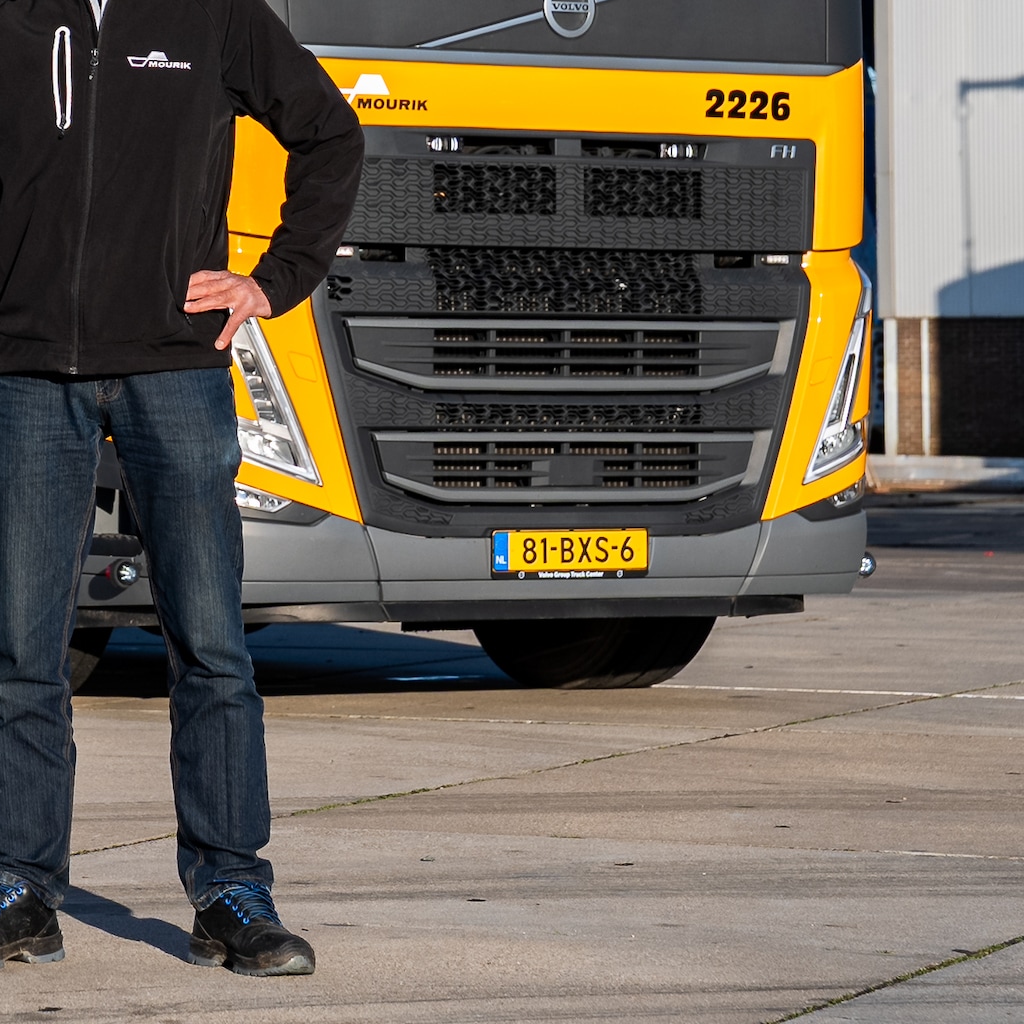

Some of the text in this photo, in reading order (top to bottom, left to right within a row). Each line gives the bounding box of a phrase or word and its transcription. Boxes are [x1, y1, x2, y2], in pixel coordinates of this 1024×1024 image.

[552, 3, 589, 11] VOLVO
[148, 60, 191, 70] MOURIK
[357, 98, 428, 111] MOURIK
[705, 88, 790, 121] 2226
[770, 144, 796, 159] FH
[522, 536, 634, 564] 81-BXS-6
[495, 555, 507, 564] NL
[554, 571, 570, 579] Group
